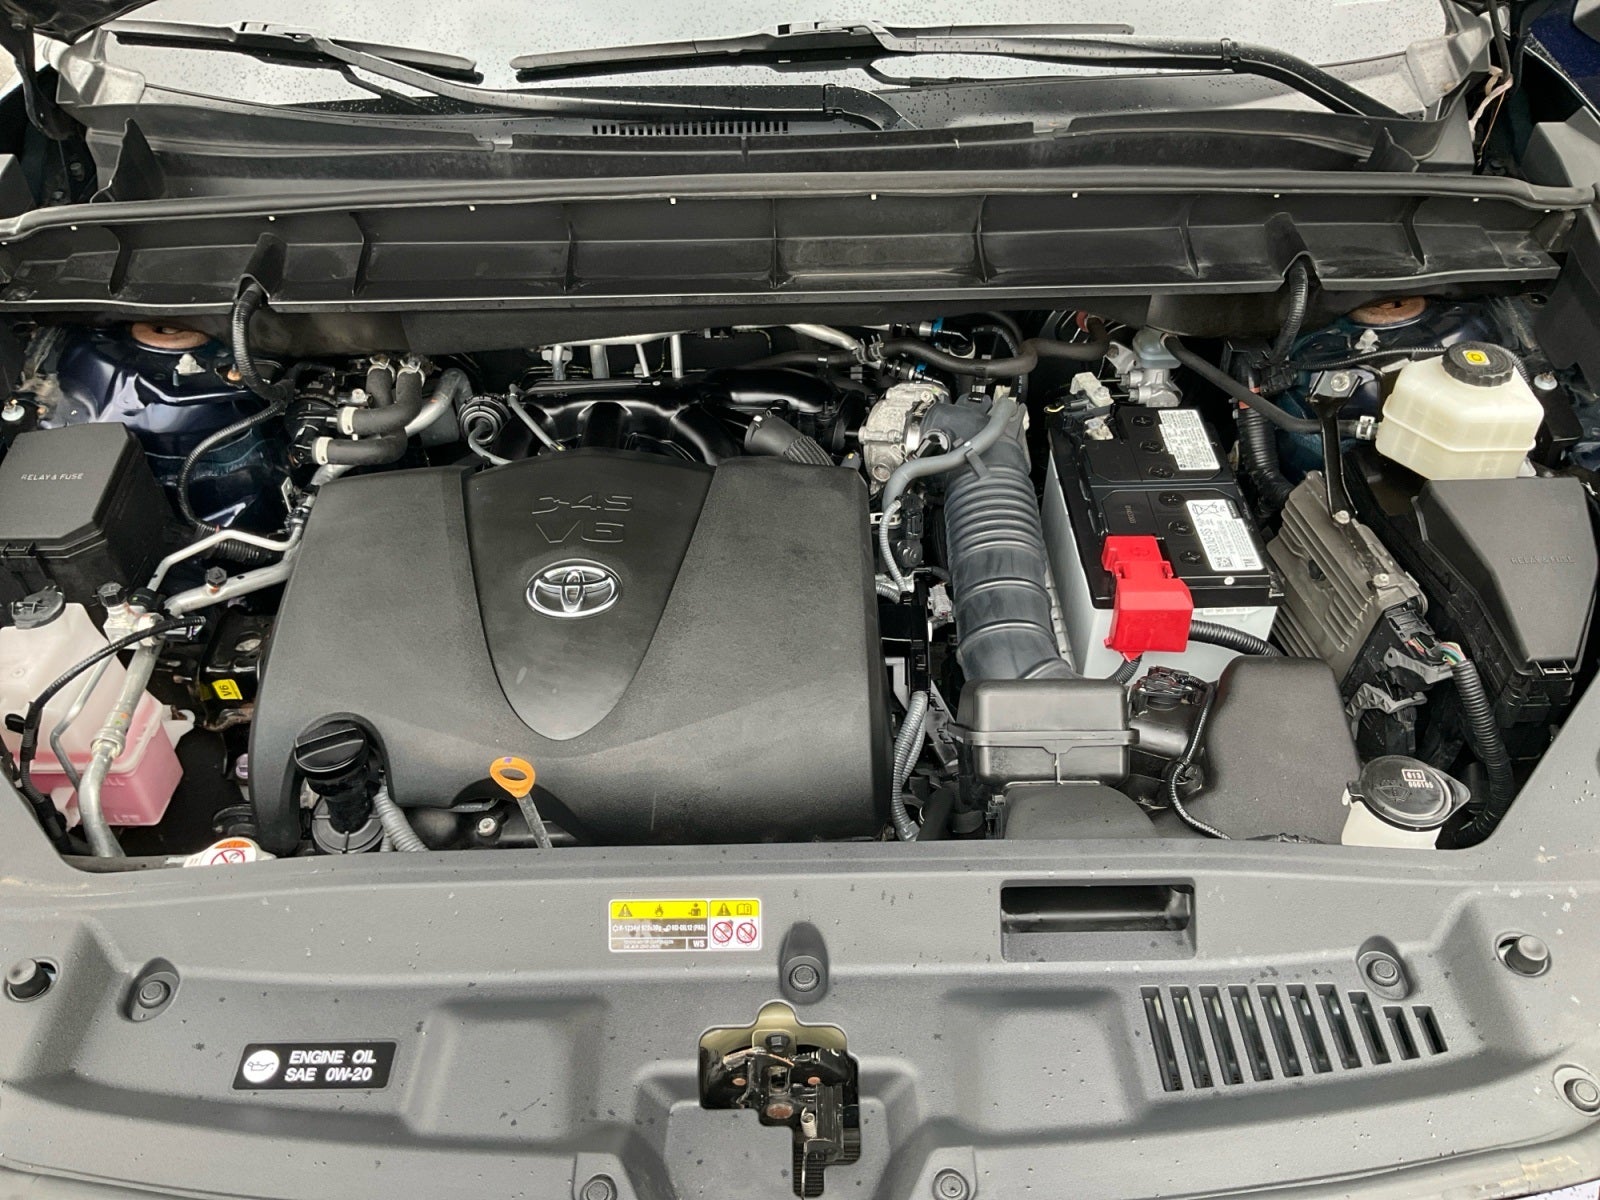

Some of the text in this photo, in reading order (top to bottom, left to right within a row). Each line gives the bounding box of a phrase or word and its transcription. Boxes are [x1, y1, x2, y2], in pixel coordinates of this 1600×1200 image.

[59, 472, 84, 480] FUSE
[535, 519, 625, 544] V6
[219, 684, 232, 697] V6
[692, 939, 706, 948] WS
[288, 1050, 377, 1065] ENGINE OIL
[284, 1066, 373, 1082] SAE 0W-20
